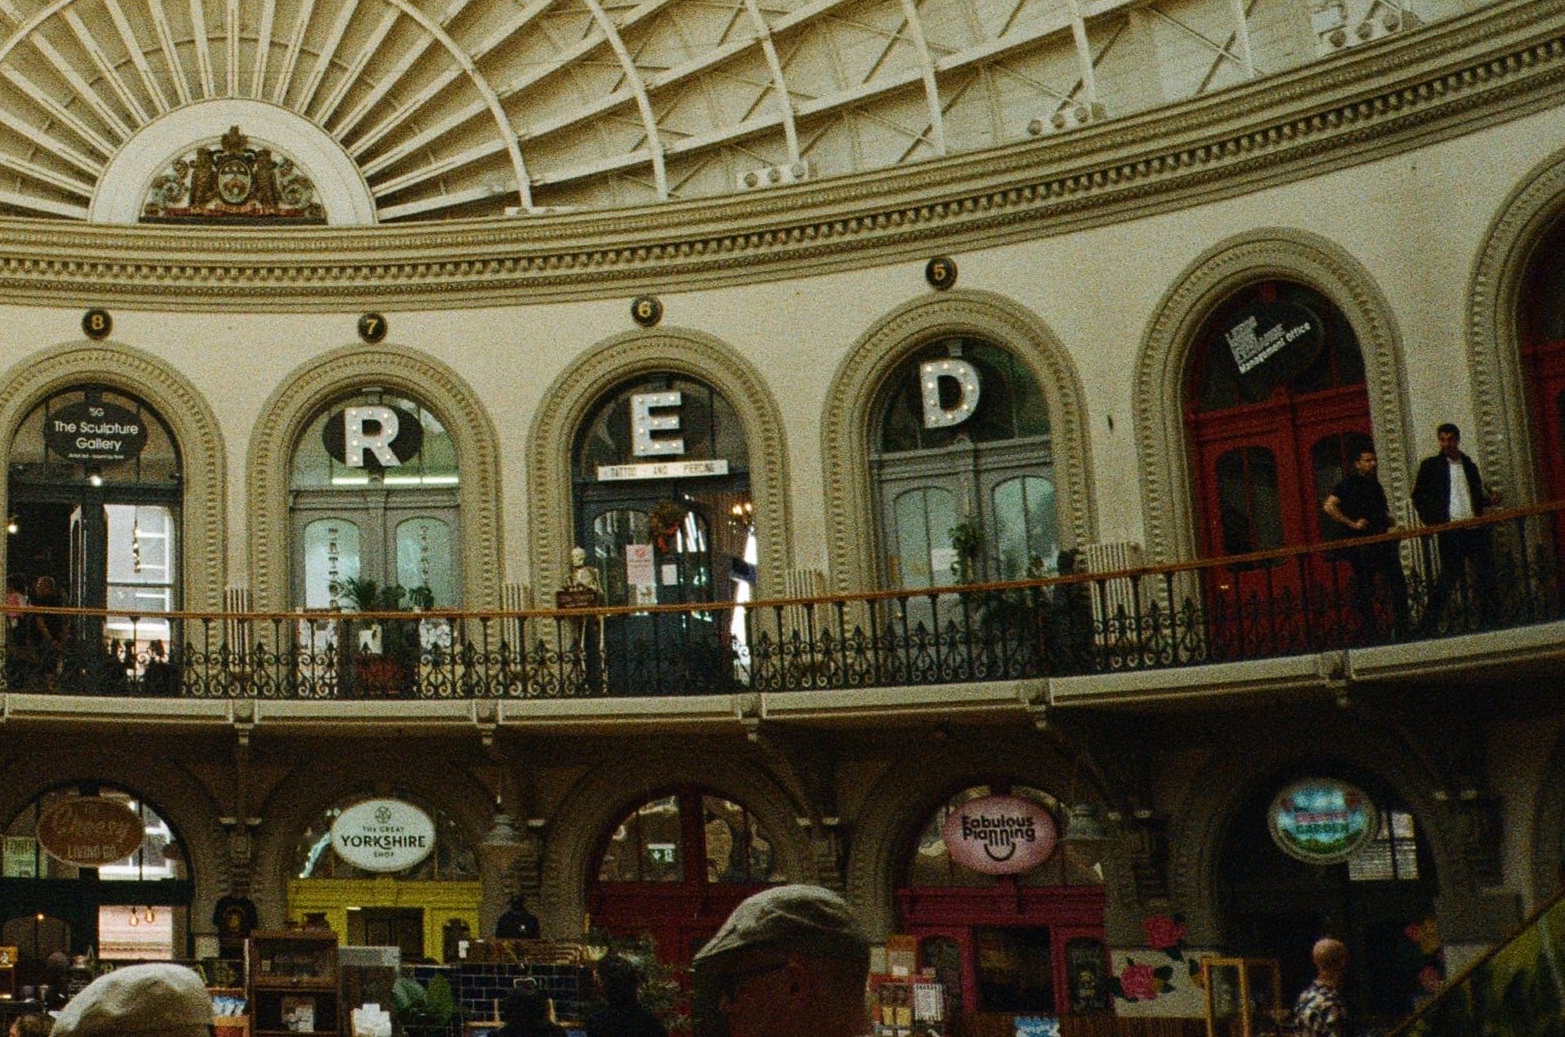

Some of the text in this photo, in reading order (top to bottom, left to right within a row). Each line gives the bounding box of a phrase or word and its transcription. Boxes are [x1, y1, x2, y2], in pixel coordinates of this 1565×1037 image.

[933, 263, 946, 281] 5
[637, 300, 651, 318] 6
[91, 314, 104, 329] 8
[365, 318, 379, 335] 7
[1285, 322, 1311, 342] Office
[920, 359, 980, 429] D
[54, 421, 139, 435] The Sculpture
[631, 391, 684, 456] E
[76, 437, 122, 451] Gallery
[344, 405, 402, 467] R
[653, 465, 668, 475] AND
[380, 825, 406, 833] GREAT
[960, 813, 1035, 829] Fabulous
[340, 834, 426, 851] YORKSHIRE
[962, 825, 1036, 847] Planning
[373, 851, 396, 859] SHOP
